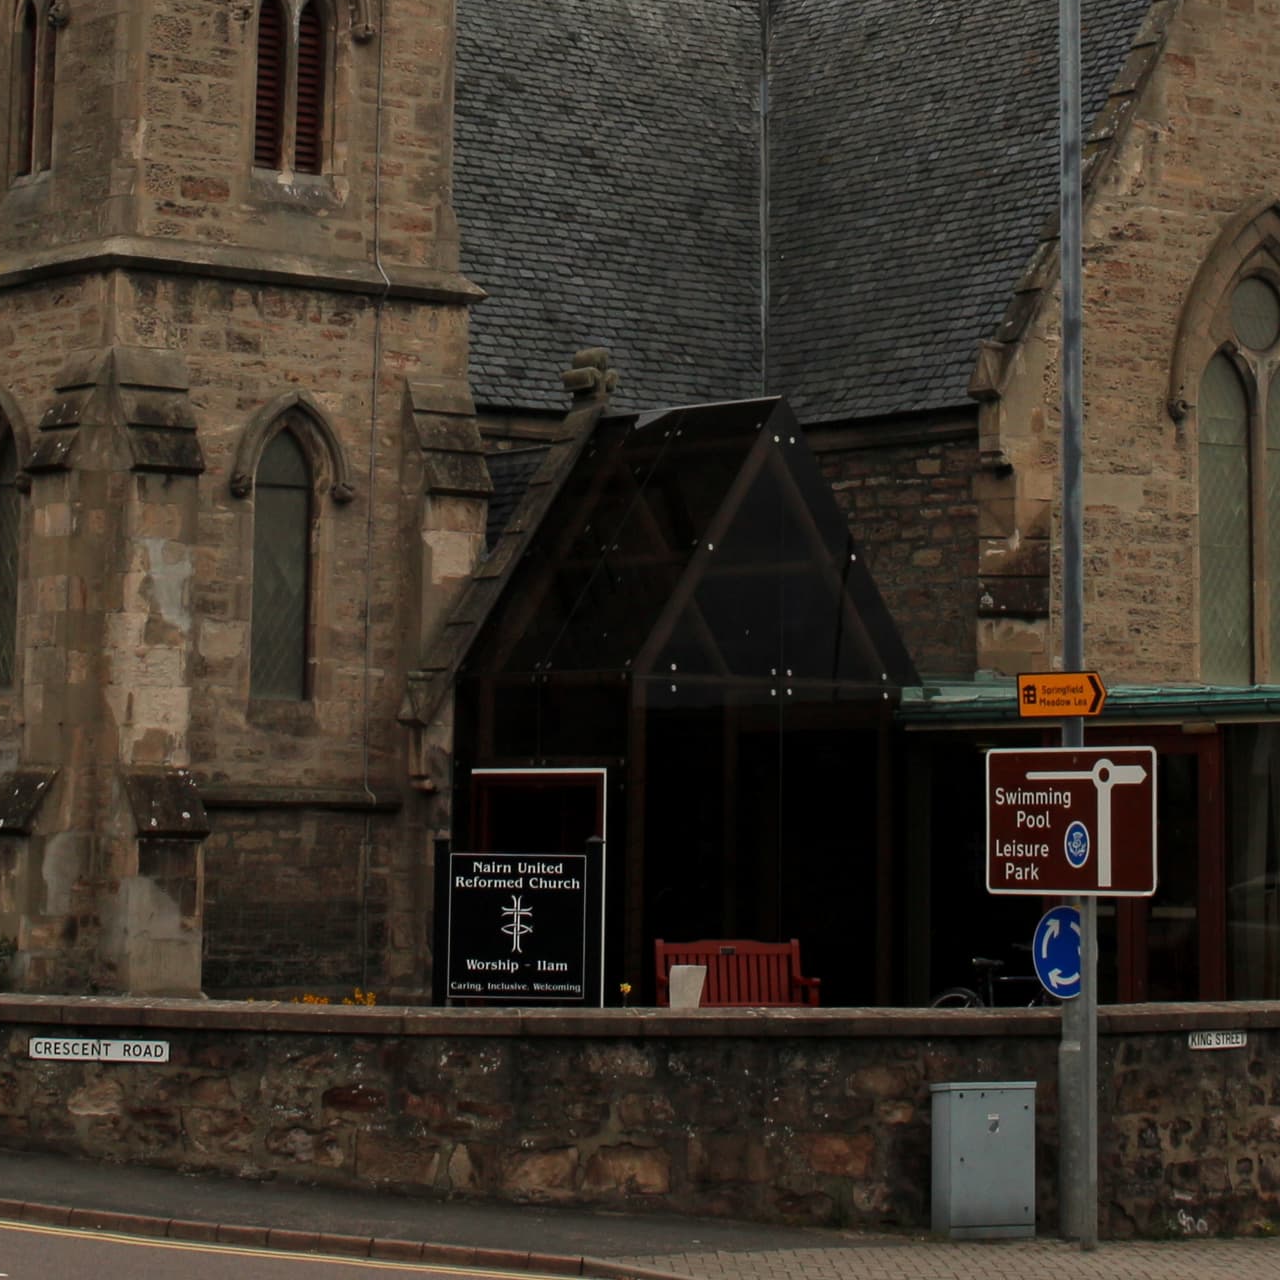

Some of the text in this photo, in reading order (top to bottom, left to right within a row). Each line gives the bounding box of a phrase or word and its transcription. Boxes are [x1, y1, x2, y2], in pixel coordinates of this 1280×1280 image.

[1041, 685, 1084, 696] Springfield
[1040, 697, 1071, 706] Meadow
[995, 787, 1071, 809] Swimming
[1016, 810, 1051, 828] Pool
[996, 839, 1049, 857] Leisure
[473, 861, 563, 874] Nairn United
[1005, 862, 1039, 880] Park
[455, 876, 580, 889] Reformed Church
[466, 959, 519, 973] Worship
[537, 960, 568, 971] 11am
[533, 983, 581, 993] Welcoming
[1191, 1032, 1245, 1046] KING STREET
[34, 1042, 164, 1058] CRESCENT ROAD
